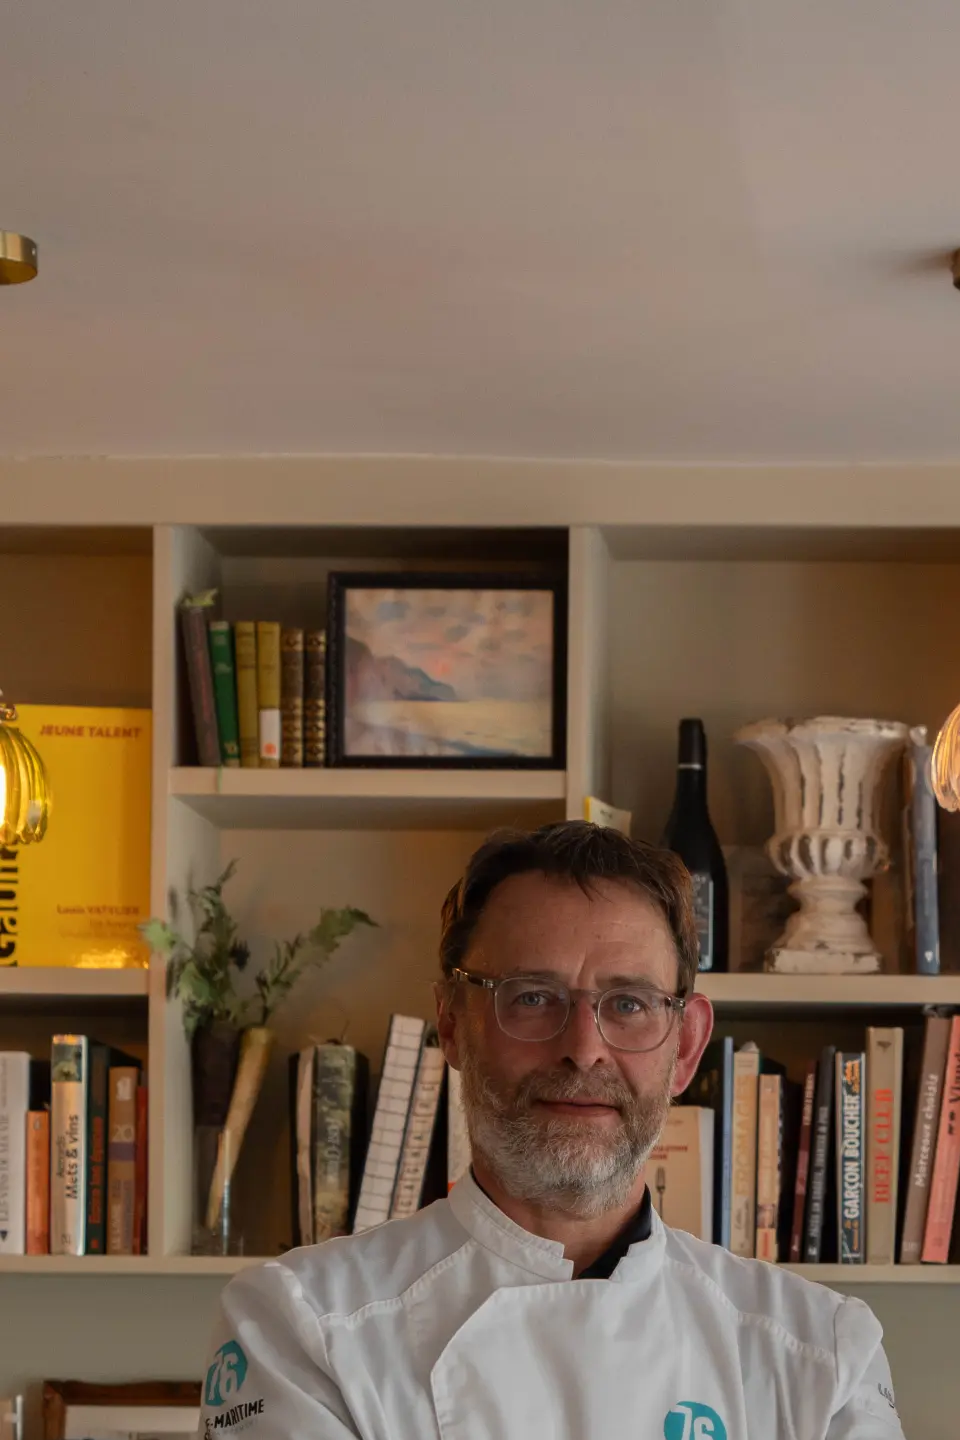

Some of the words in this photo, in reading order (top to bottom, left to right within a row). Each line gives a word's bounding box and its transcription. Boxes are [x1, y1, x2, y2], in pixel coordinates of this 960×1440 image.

[40, 724, 85, 737] JEUNE
[89, 725, 143, 738] TALENT
[873, 1088, 893, 1144] CLUB
[922, 1073, 939, 1120] choisis
[65, 1114, 79, 1144] vins
[735, 1074, 751, 1196] FROMAGES
[842, 1094, 861, 1157] BOUCHER
[55, 1134, 65, 1178] Accords
[66, 1148, 79, 1159] &
[872, 1150, 891, 1203] BEEF
[914, 1123, 931, 1187] Morceaux
[66, 1163, 79, 1199] Mets
[843, 1161, 864, 1219] GARÇON
